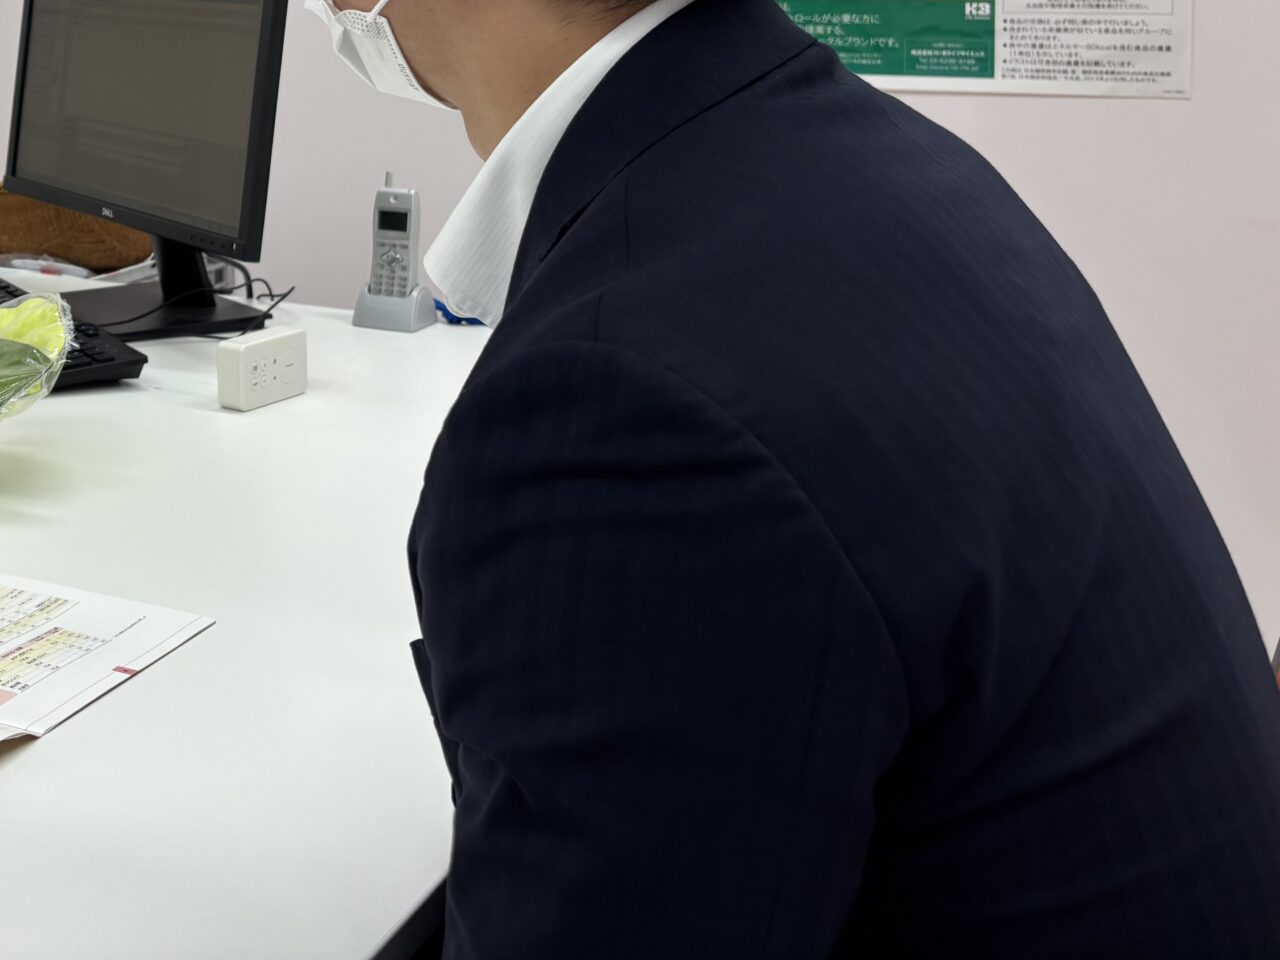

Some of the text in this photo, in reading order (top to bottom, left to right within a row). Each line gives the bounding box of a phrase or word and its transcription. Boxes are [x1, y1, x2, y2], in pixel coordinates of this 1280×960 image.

[788, 13, 880, 24] ロールが必要な方に
